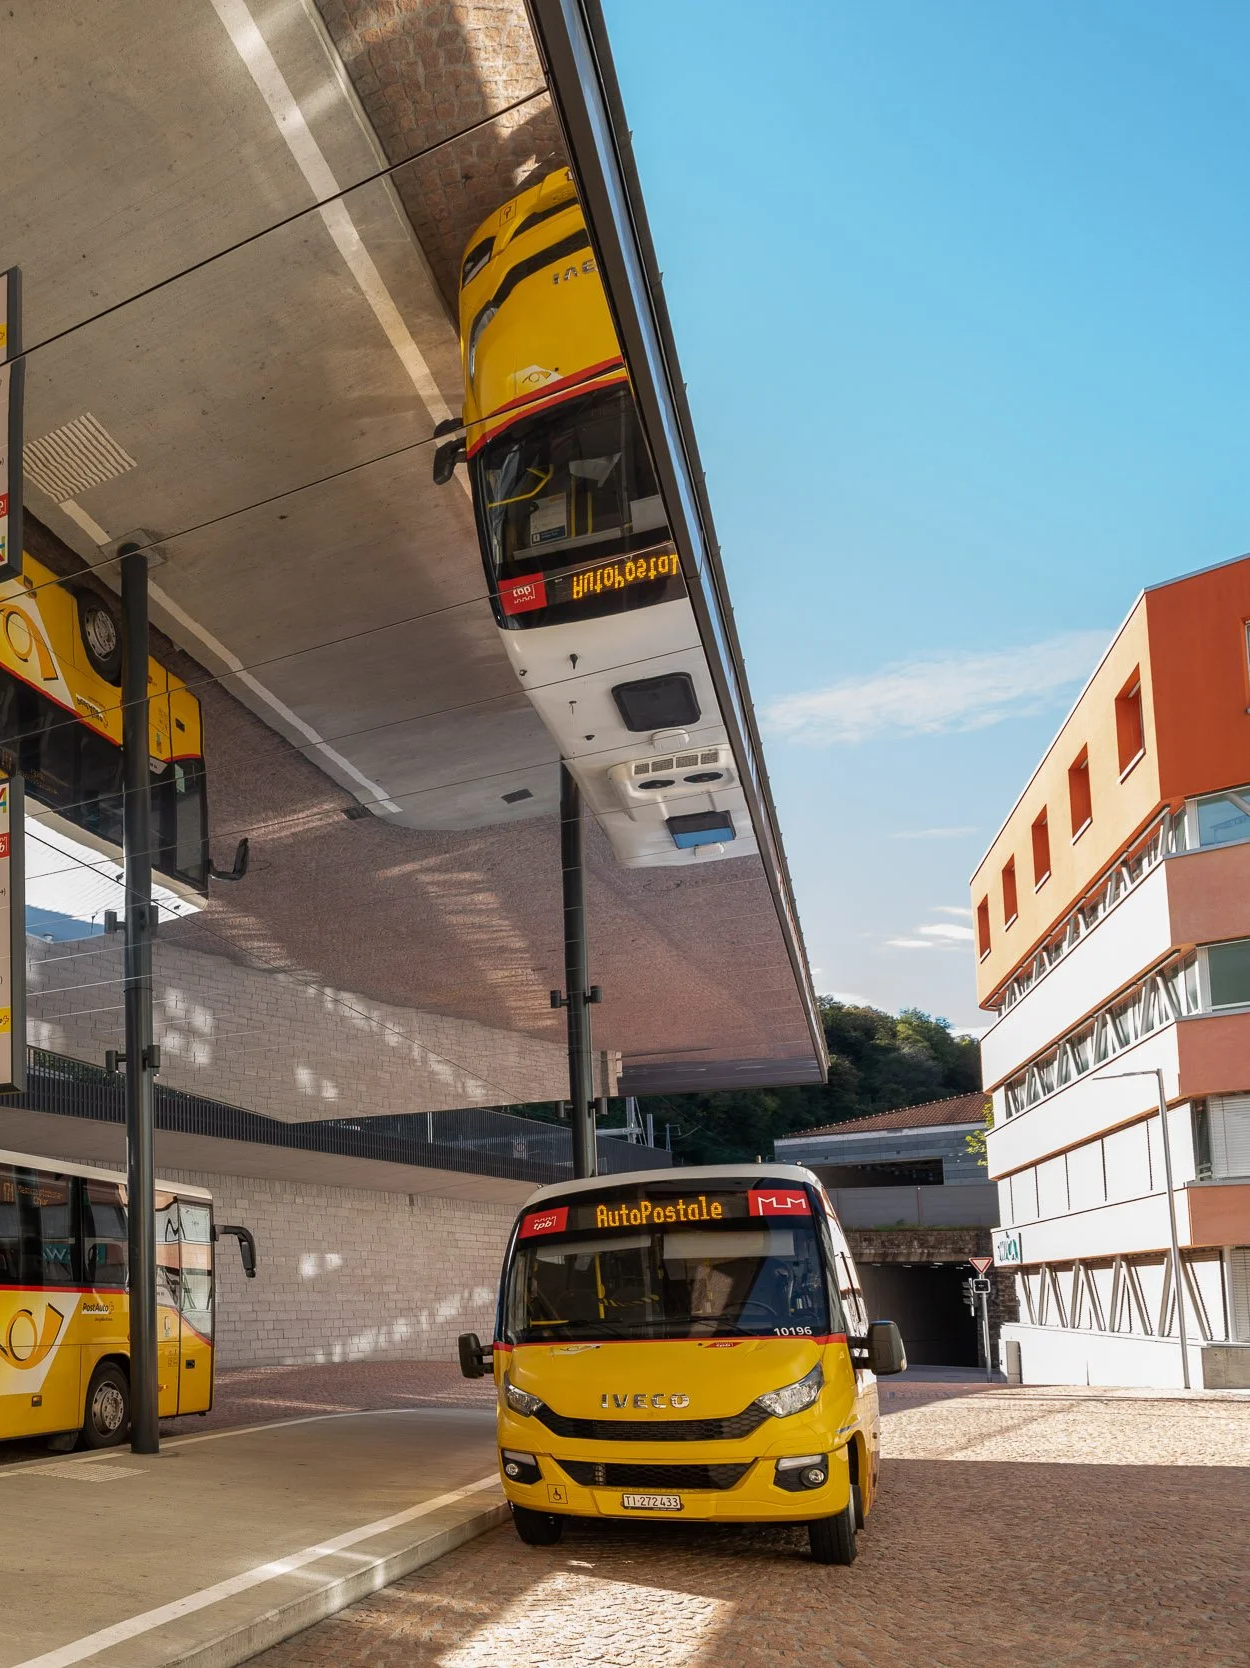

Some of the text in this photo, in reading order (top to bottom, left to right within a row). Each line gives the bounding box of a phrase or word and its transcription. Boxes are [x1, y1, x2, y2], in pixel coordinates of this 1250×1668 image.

[596, 1196, 724, 1229] AutoPostale
[533, 1219, 553, 1232] tpb
[82, 1303, 109, 1312] PostAuto
[773, 1325, 812, 1337] 10196
[600, 1393, 690, 1409] IVECO
